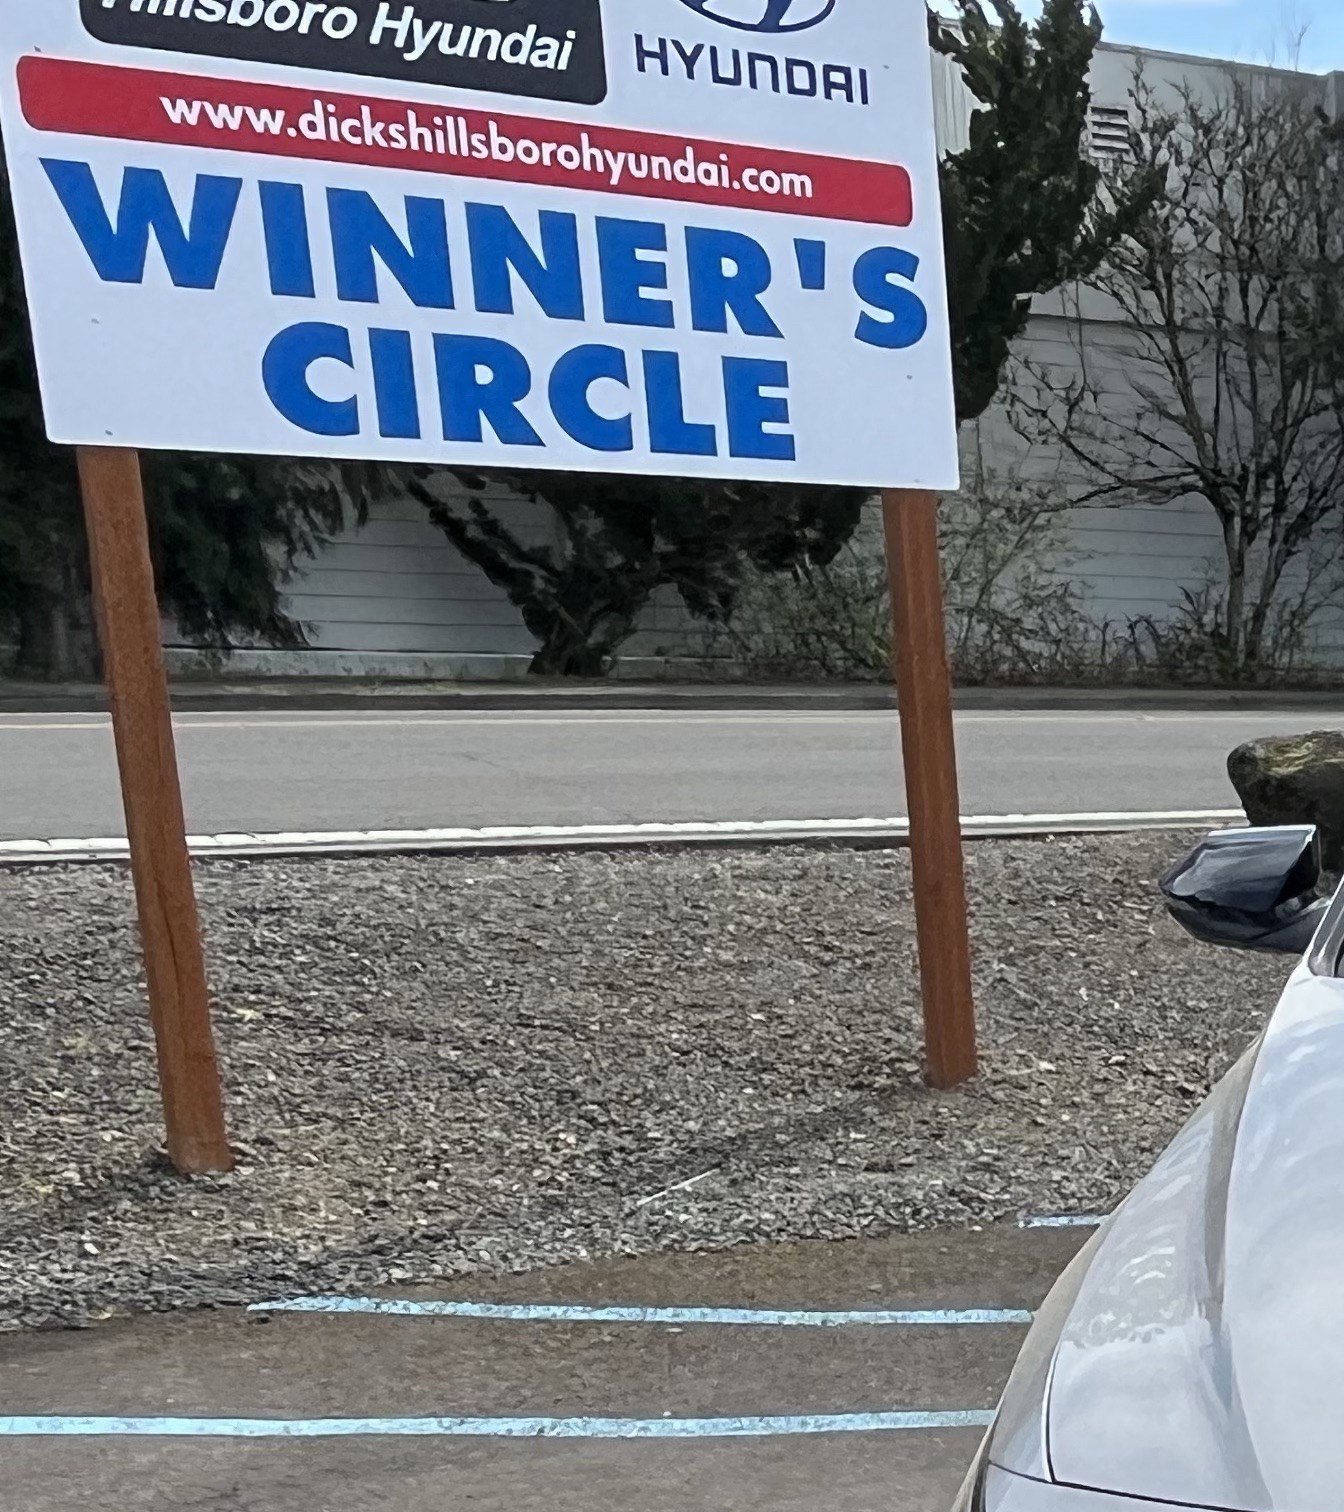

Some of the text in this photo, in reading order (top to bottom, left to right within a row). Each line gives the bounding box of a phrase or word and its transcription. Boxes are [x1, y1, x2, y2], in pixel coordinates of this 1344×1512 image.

[369, 3, 576, 70] Hyundai
[634, 33, 869, 105] HYUNDAI
[159, 96, 813, 198] www.dickshillsborohyundai.com
[40, 158, 928, 349] WINNER'S
[262, 321, 796, 461] CIRCLE
